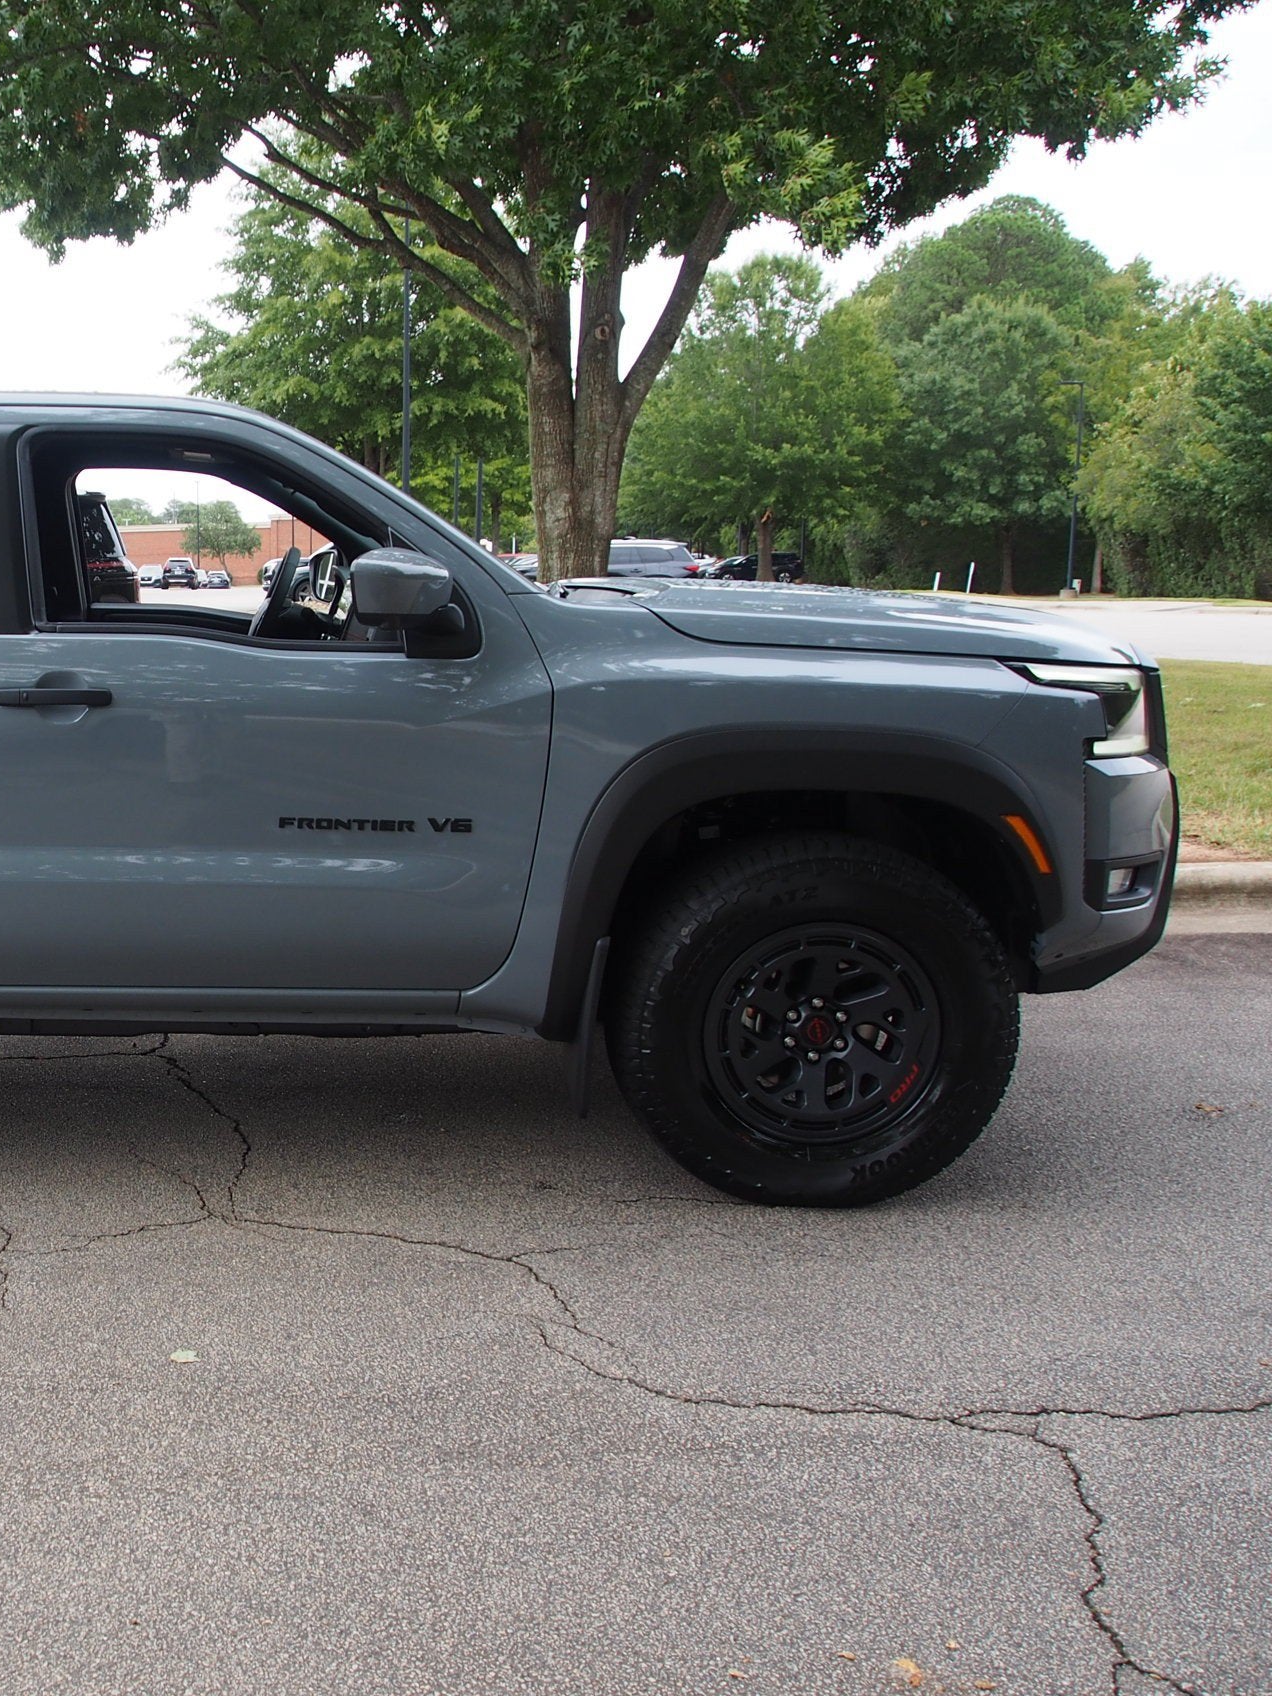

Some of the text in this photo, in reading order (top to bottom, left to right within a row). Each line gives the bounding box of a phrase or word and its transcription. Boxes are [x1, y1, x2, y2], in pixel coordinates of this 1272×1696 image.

[278, 816, 474, 833] FRONTIER V6
[888, 1062, 921, 1104] PRO
